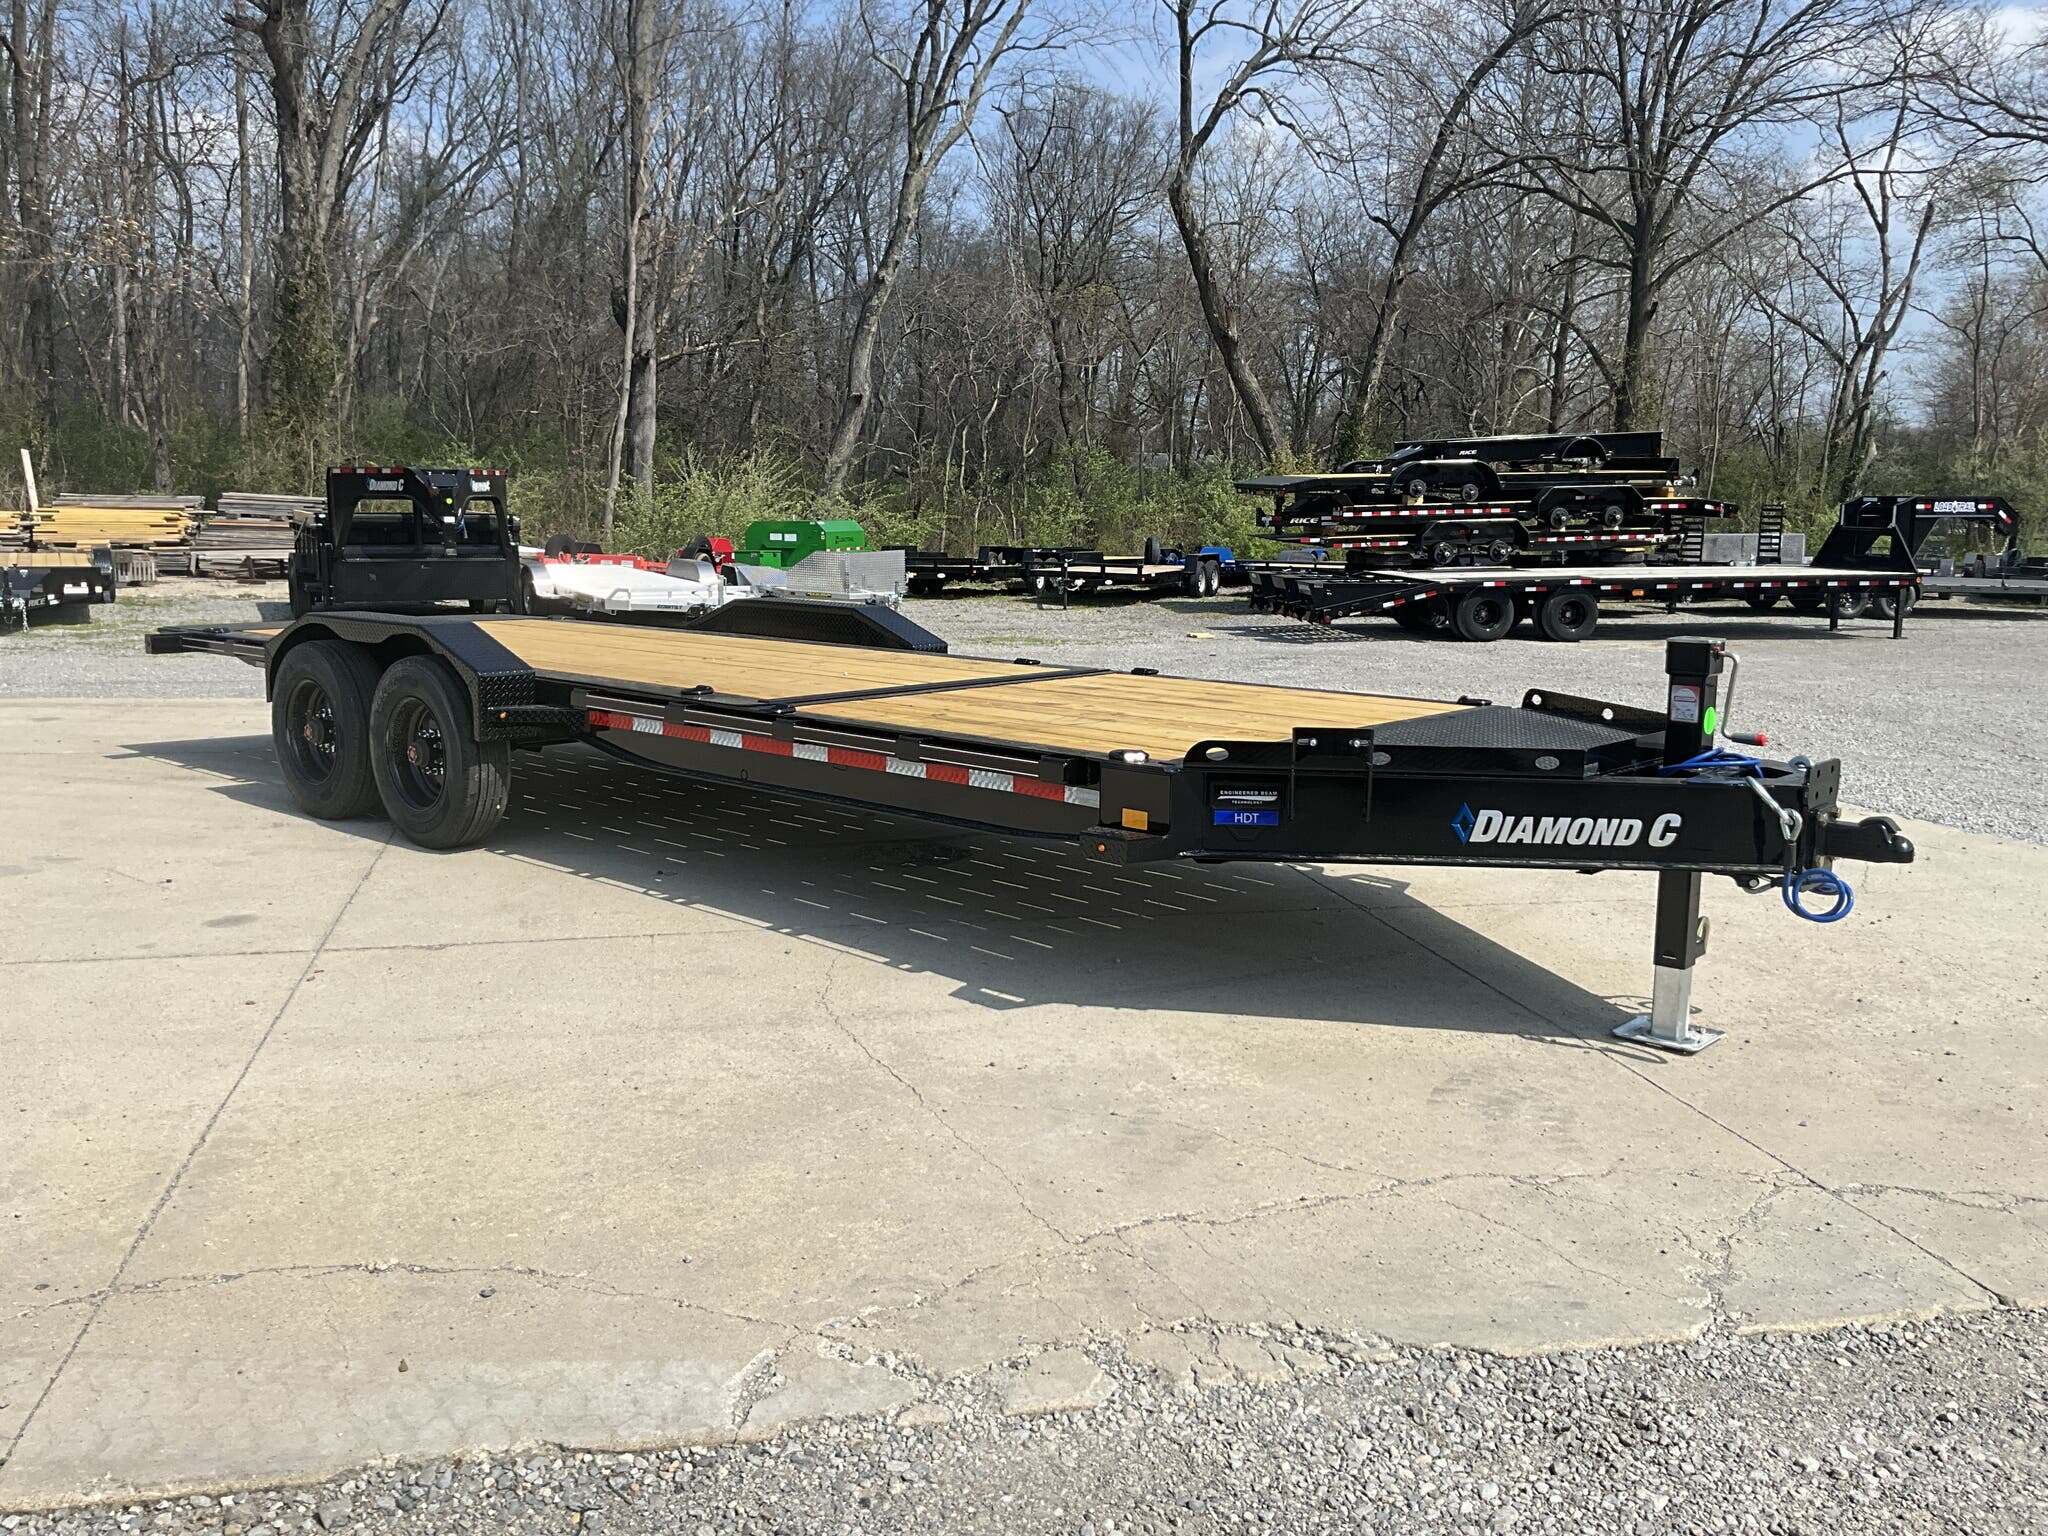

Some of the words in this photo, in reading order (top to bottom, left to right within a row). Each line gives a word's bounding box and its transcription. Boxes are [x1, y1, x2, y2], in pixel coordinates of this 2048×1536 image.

[398, 479, 405, 491] C
[1234, 812, 1260, 824] HDT
[1469, 808, 1643, 847] DIAMOND
[1648, 812, 1682, 848] C
